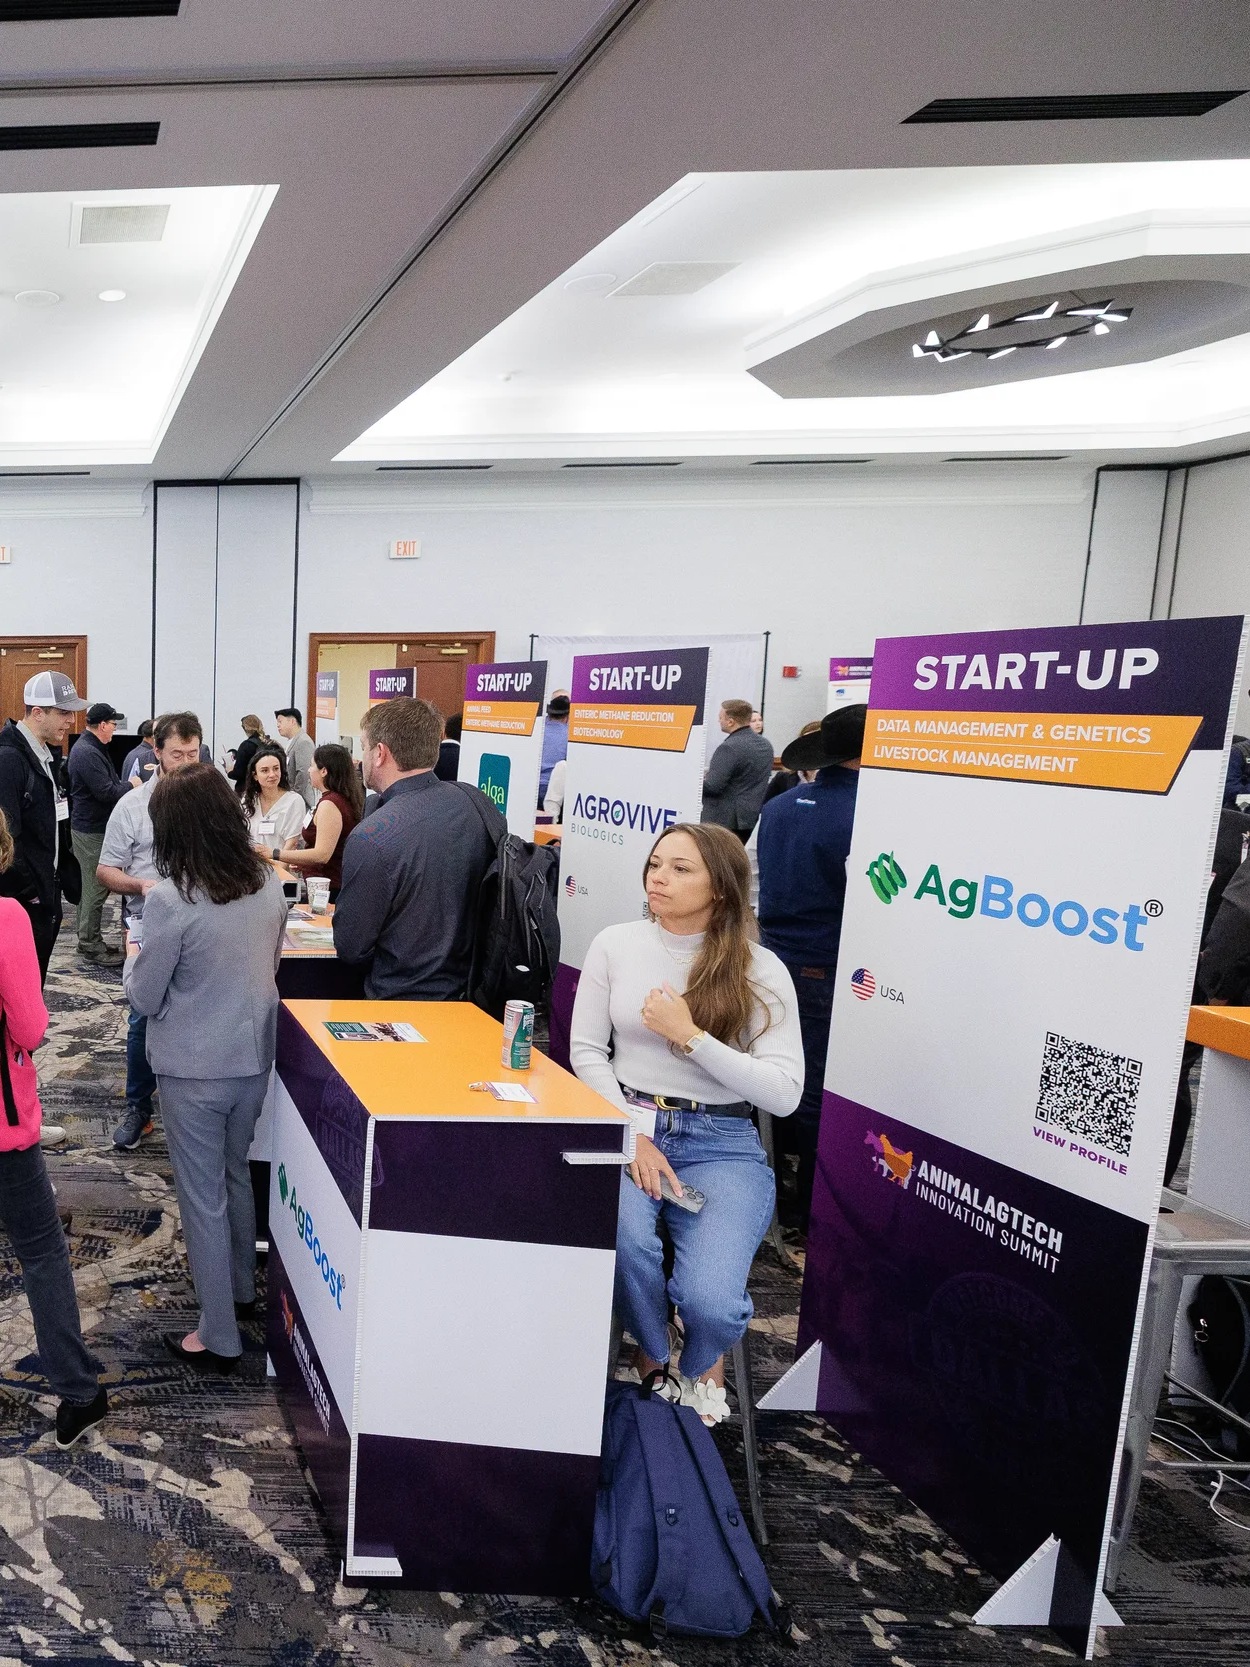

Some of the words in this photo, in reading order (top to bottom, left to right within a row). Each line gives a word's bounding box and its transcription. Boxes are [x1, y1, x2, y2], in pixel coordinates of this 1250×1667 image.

[396, 541, 417, 556] EXIT
[589, 664, 682, 691] START-UP
[913, 648, 1160, 691] START-UP
[375, 677, 407, 692] START-UP
[476, 672, 533, 692] START-UP
[500, 720, 526, 730] REDUCTION
[574, 709, 599, 719] ENTERIC
[599, 710, 630, 721] METHANE
[631, 711, 675, 723] REDUCTION
[573, 726, 625, 739] BIOTECHNOLOGY
[876, 719, 911, 733] DATA
[914, 720, 1029, 739] MANAGEMENT
[1031, 724, 1045, 739] &
[1049, 724, 1151, 744] GENETICS
[874, 746, 949, 764] LIVESTOCK
[952, 753, 1078, 773] MANAGEMENT
[571, 823, 624, 845] BIOLOGICS
[577, 885, 589, 896] USA
[880, 985, 906, 1004] USA
[1032, 1126, 1066, 1149] VIEW
[1069, 1143, 1128, 1176] PROFILE
[917, 1160, 1063, 1254] ANIMALAGTECH
[916, 1181, 995, 1239] INNOVATION
[1000, 1229, 1059, 1274] SUMMIT
